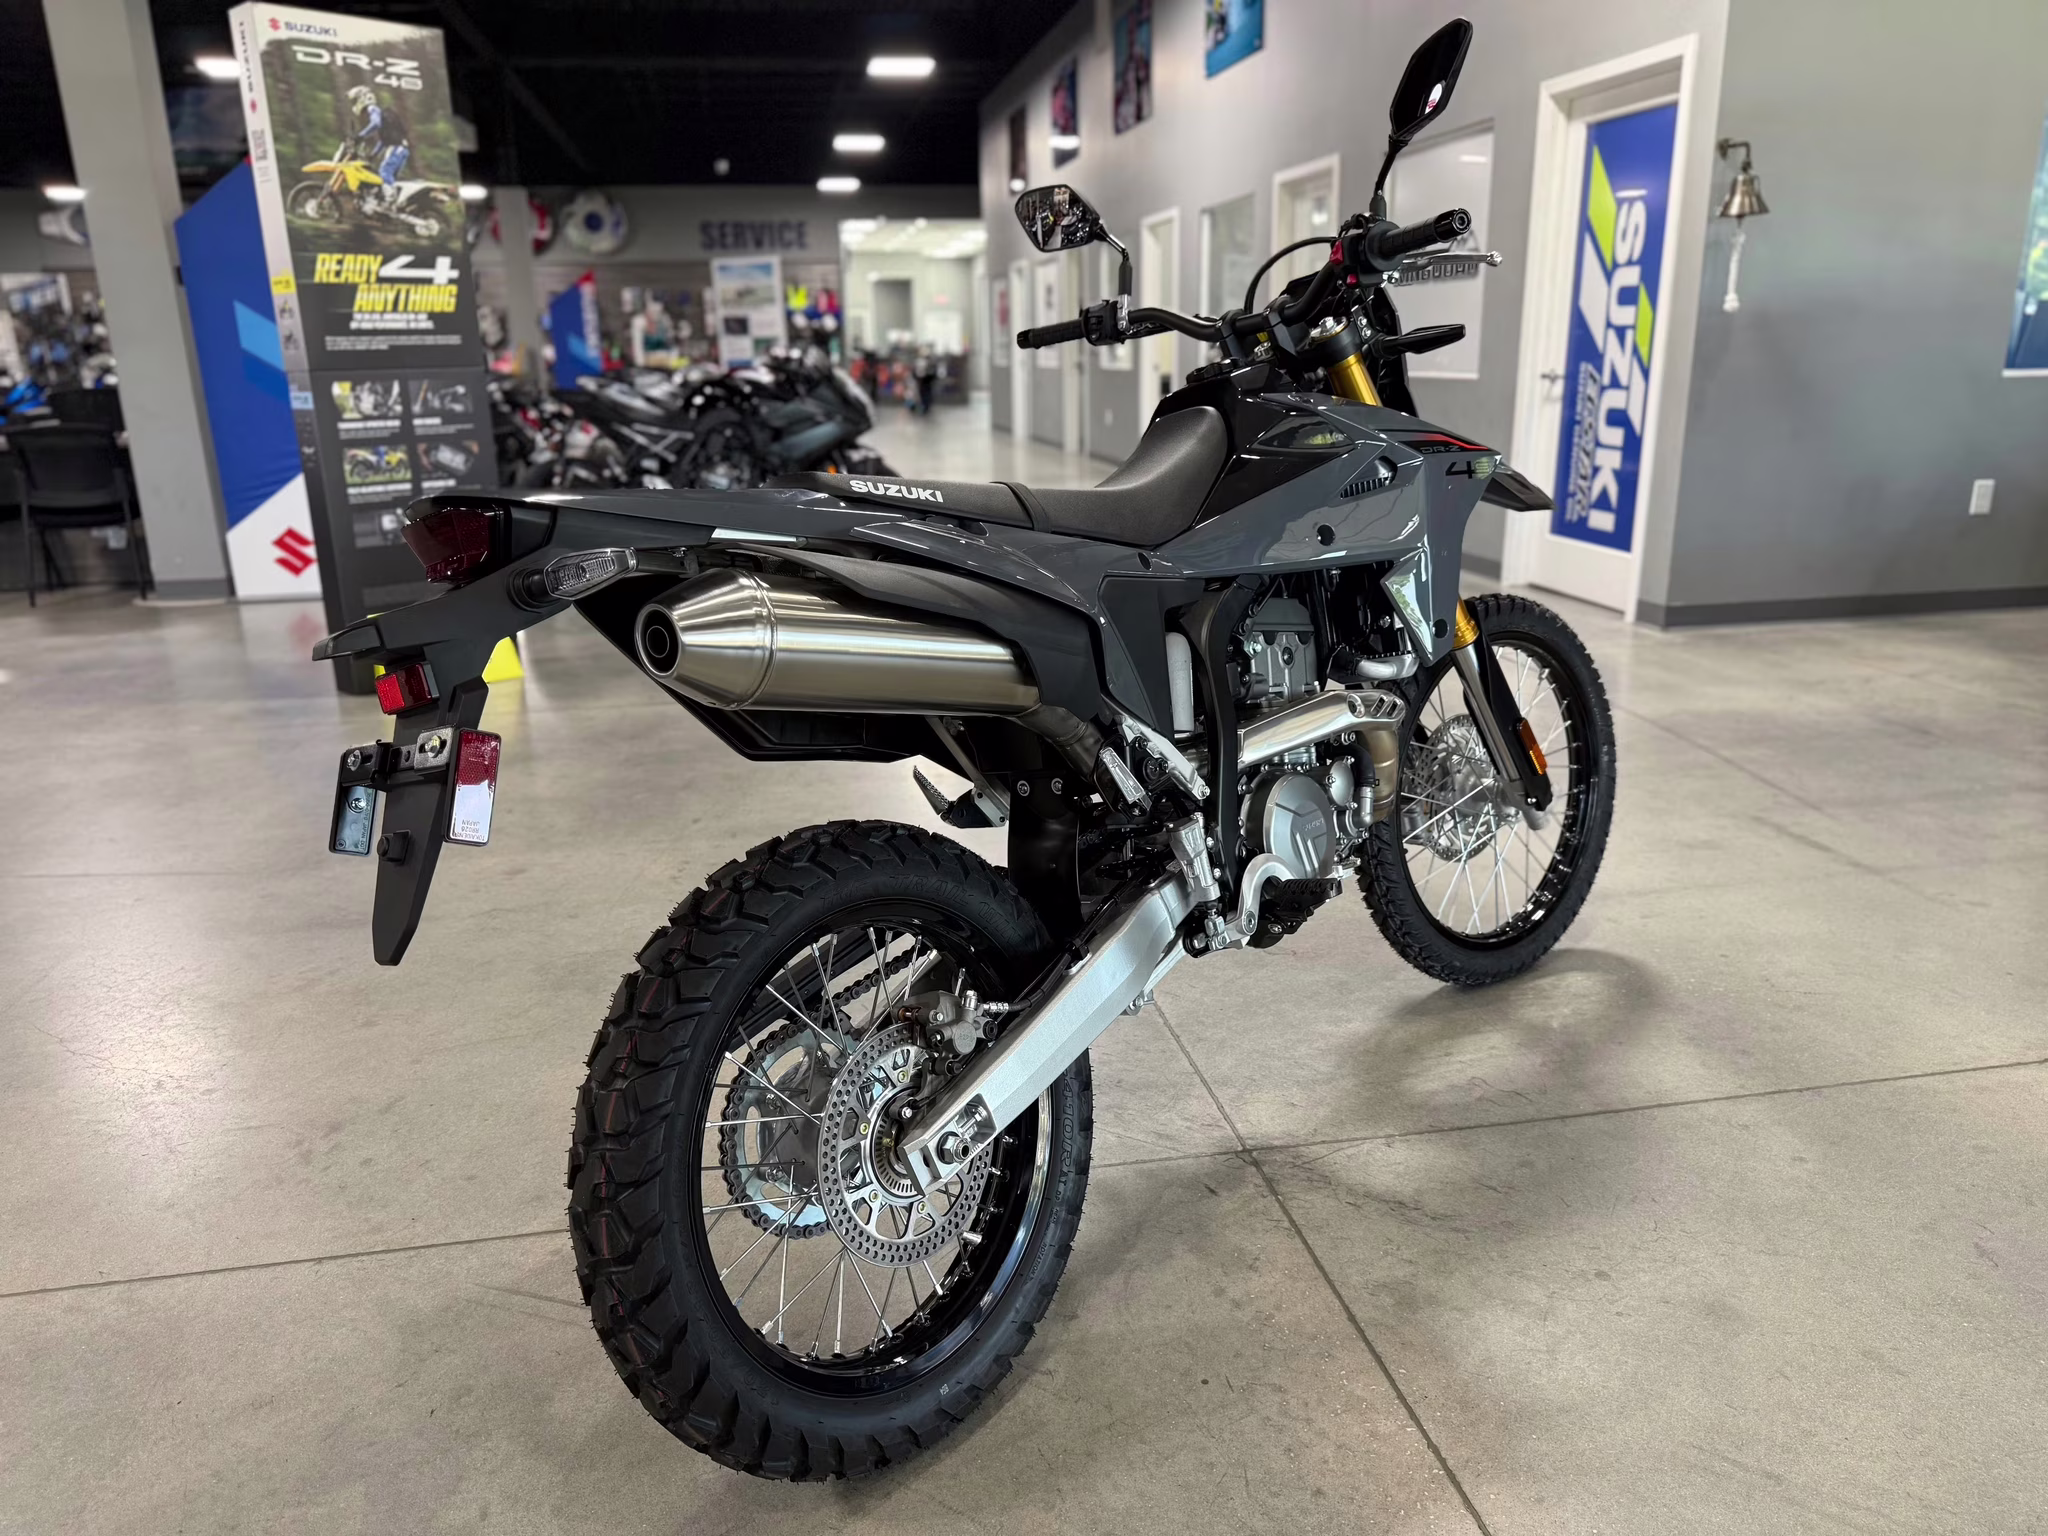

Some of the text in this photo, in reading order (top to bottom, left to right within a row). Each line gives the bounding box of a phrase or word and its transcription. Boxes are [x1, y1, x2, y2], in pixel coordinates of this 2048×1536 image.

[284, 21, 338, 37] SUZUKI
[292, 45, 421, 77] DR-Z
[700, 220, 809, 251] SERVICE
[314, 252, 460, 285] READY 4
[353, 283, 459, 314] ANYTHING
[1588, 199, 1647, 533] SUZUKI
[1420, 445, 1462, 454] DR-Z
[849, 479, 944, 503] SUZUKI
[461, 818, 481, 827] JAPAN
